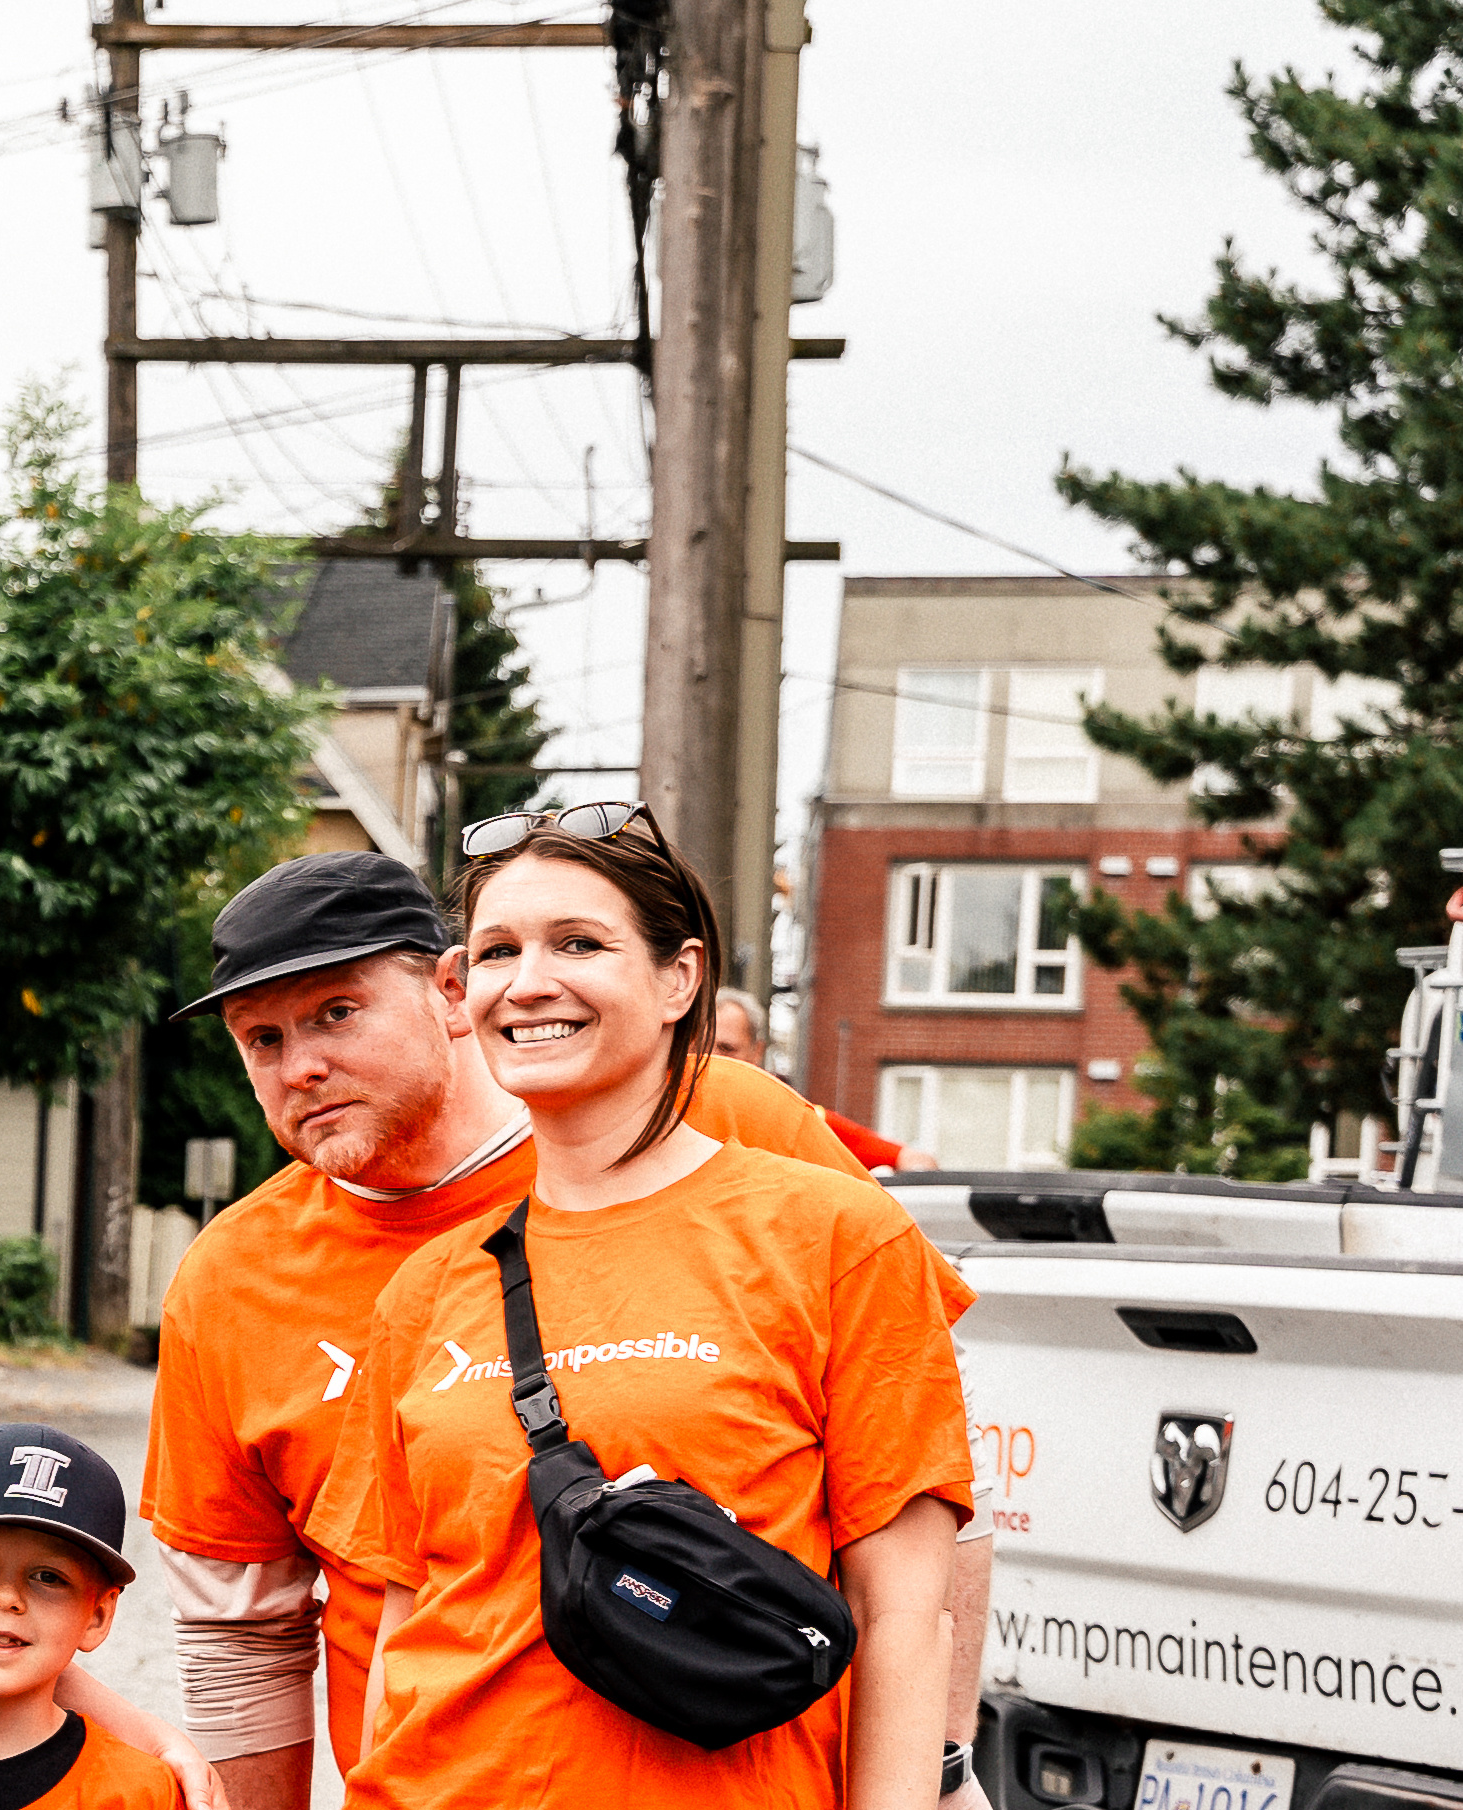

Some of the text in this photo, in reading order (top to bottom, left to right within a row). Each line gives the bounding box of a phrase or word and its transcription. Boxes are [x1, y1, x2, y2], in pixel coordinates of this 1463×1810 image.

[463, 1331, 721, 1383] misonpossible
[1265, 1458, 1463, 1530] 604-25-
[992, 1608, 1458, 1717] w.mpmaintenance.
